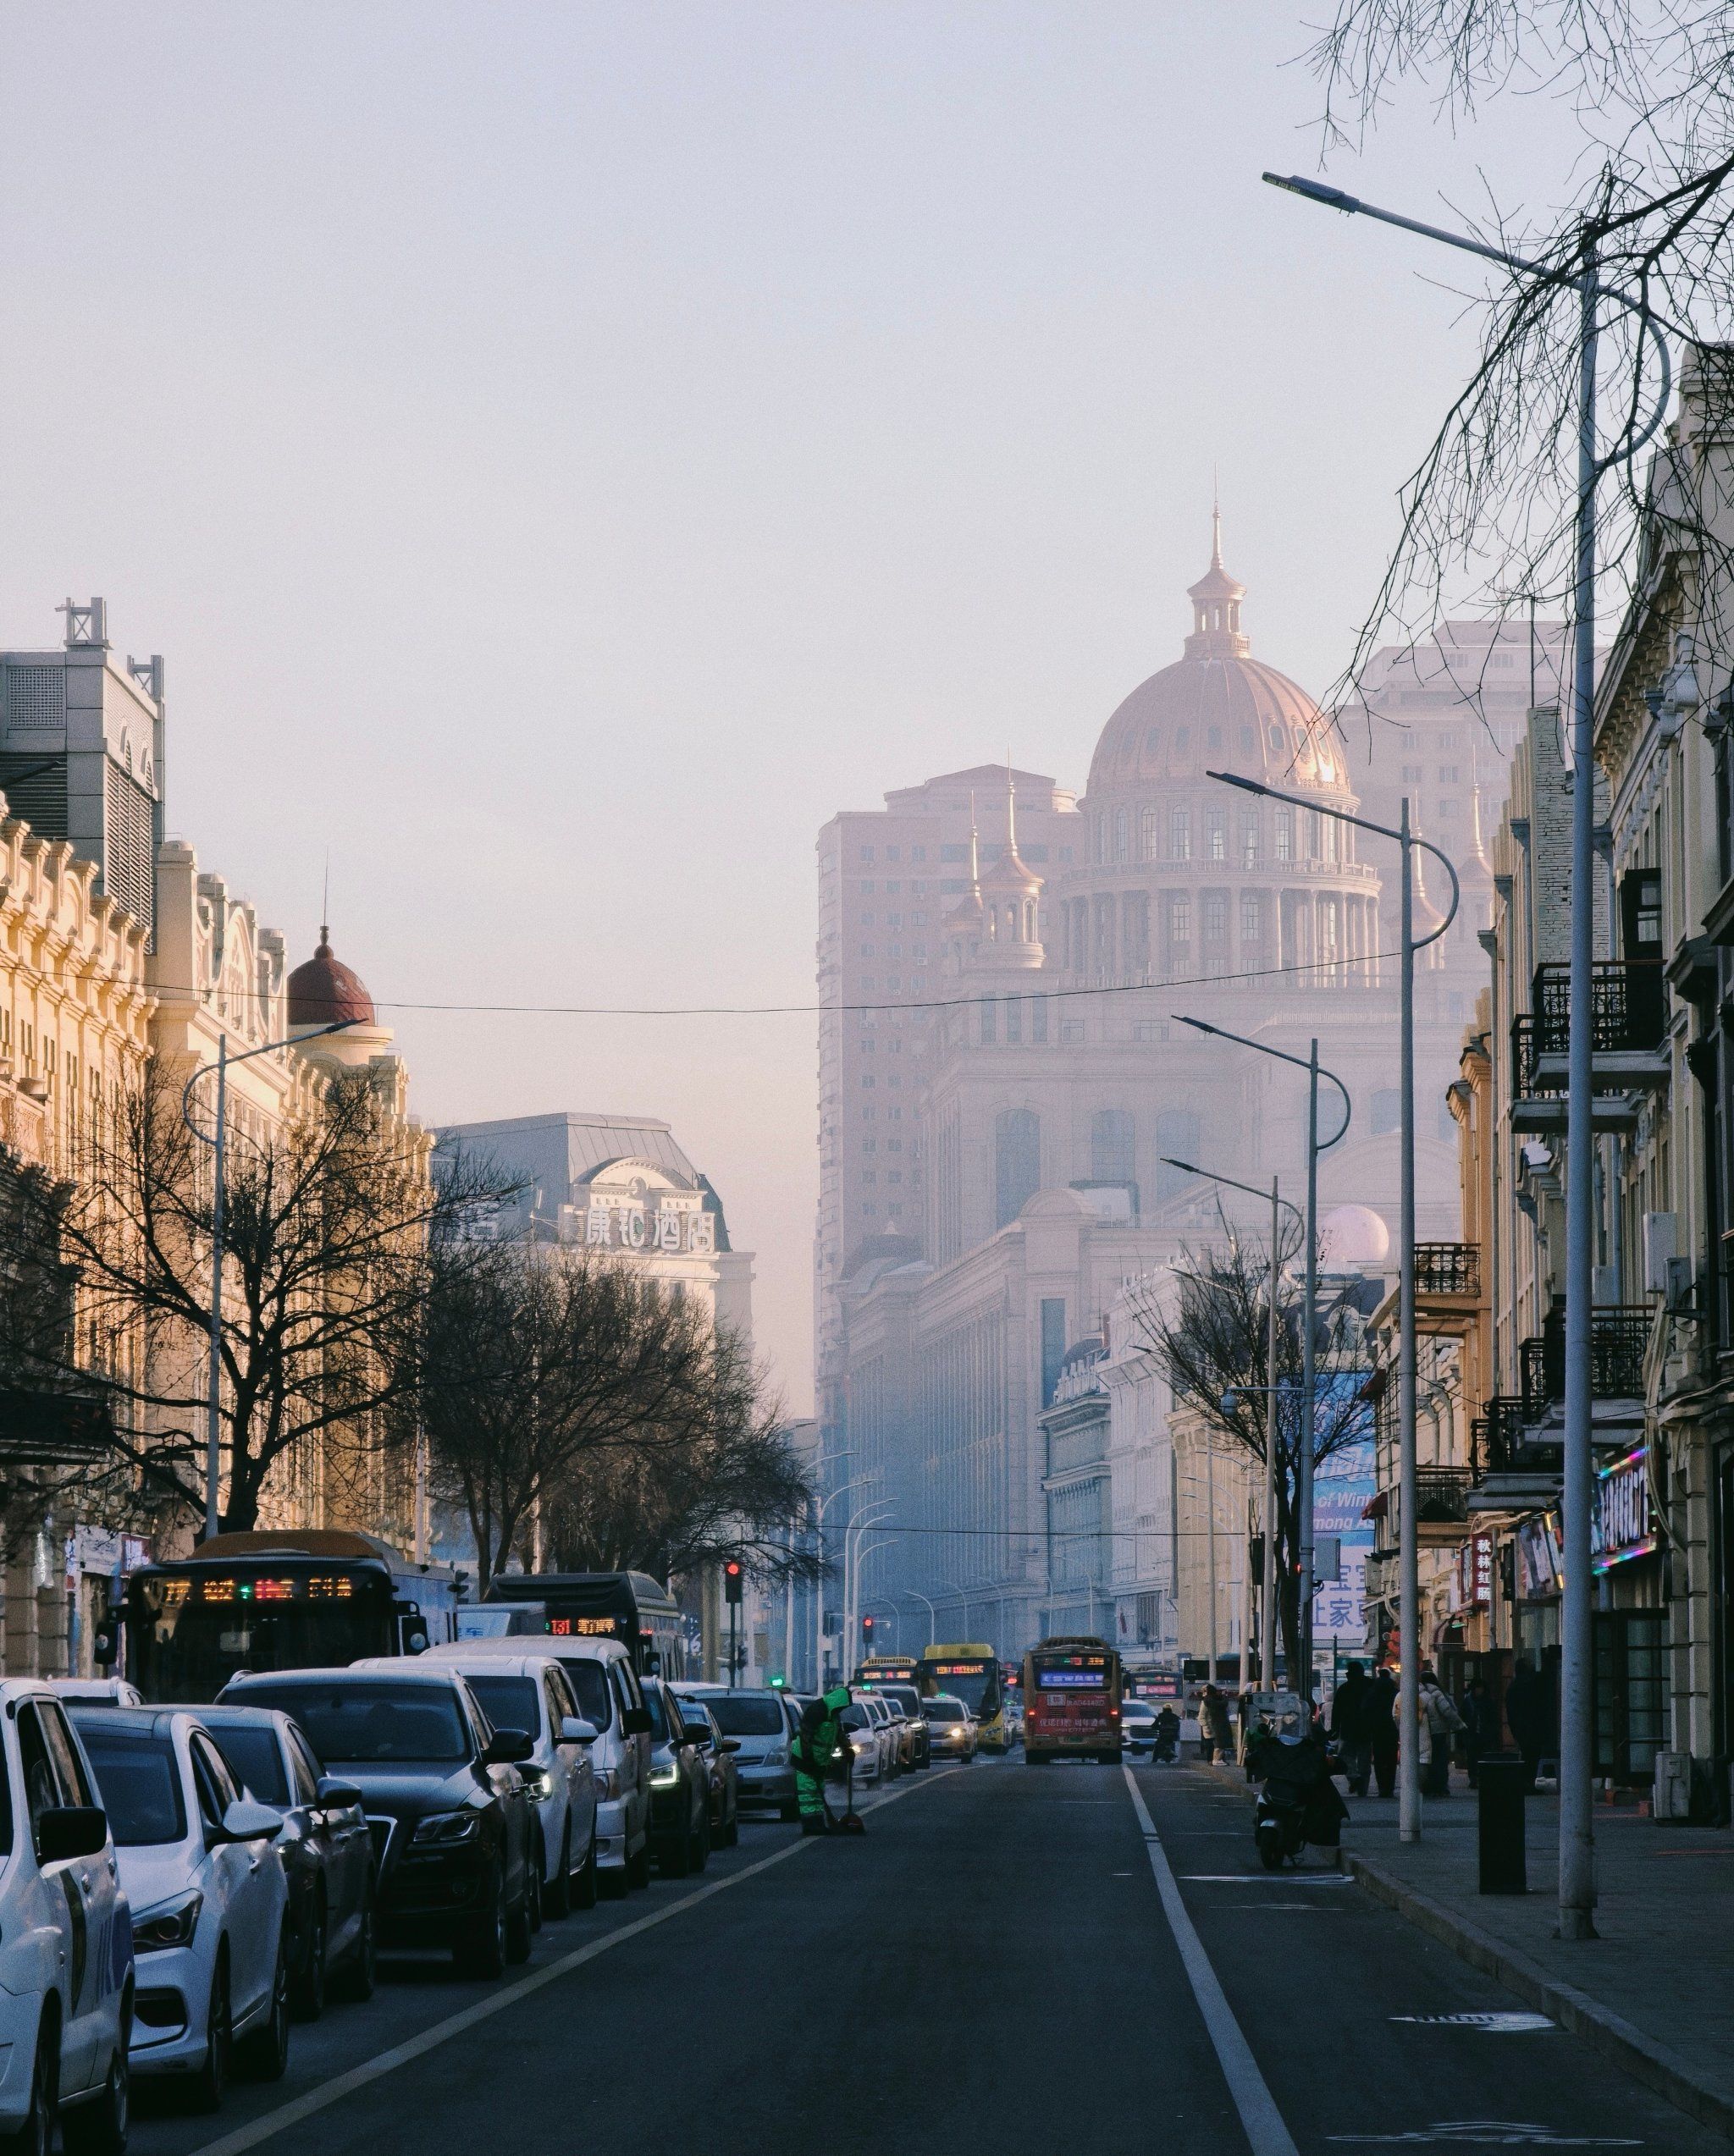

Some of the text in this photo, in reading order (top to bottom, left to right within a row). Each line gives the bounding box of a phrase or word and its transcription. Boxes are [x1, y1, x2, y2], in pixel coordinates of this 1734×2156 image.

[1318, 1492, 1372, 1508] of Wint
[1313, 1517, 1353, 1530] mong
[1477, 1539, 1491, 1601] 秋林红肠
